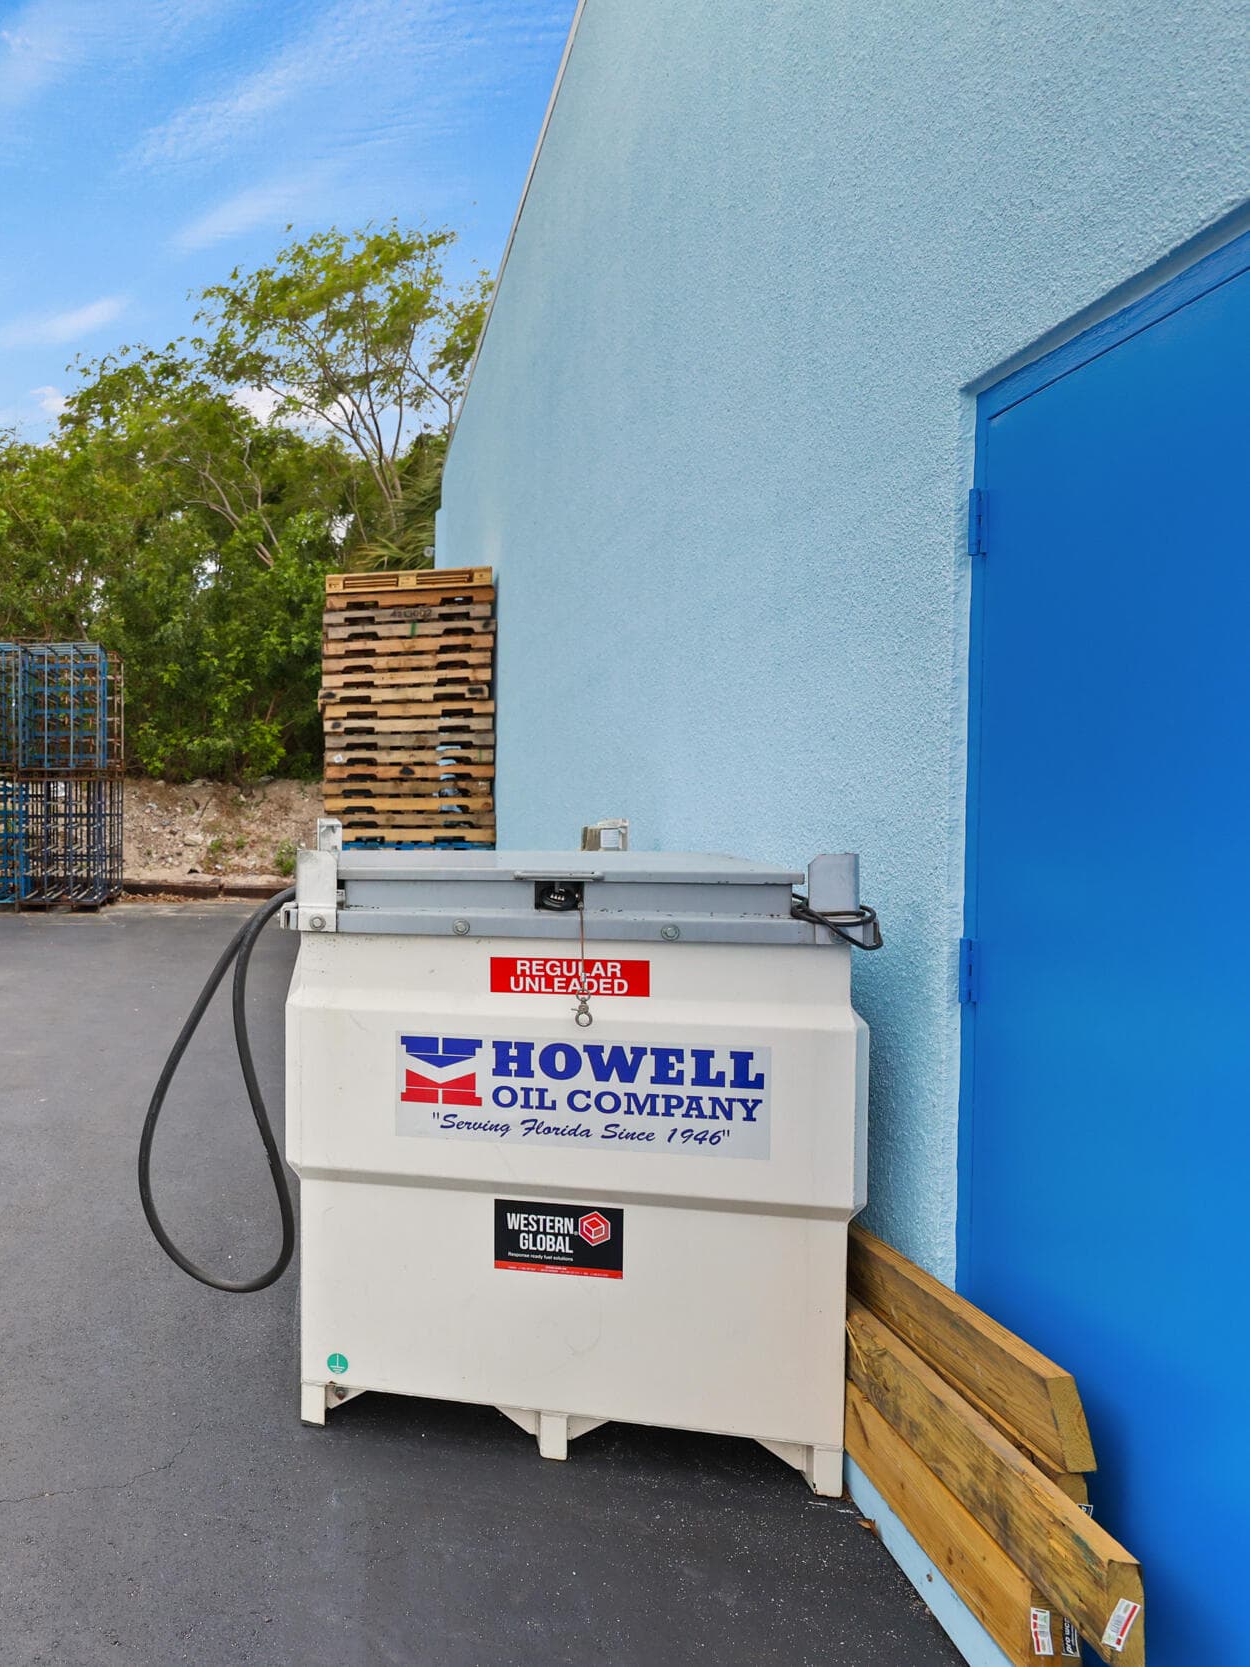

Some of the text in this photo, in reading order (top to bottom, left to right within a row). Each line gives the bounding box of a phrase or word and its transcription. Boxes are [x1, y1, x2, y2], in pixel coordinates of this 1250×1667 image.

[516, 960, 622, 977] REGULAR
[509, 976, 629, 995] UNLEADED
[492, 1040, 765, 1090] HOWELL
[491, 1085, 763, 1122] OIL COMPANY
[432, 1112, 730, 1146] "Serving Florida Since 1946"
[506, 1212, 574, 1235] WESTERN
[519, 1233, 574, 1253] GLOBAL
